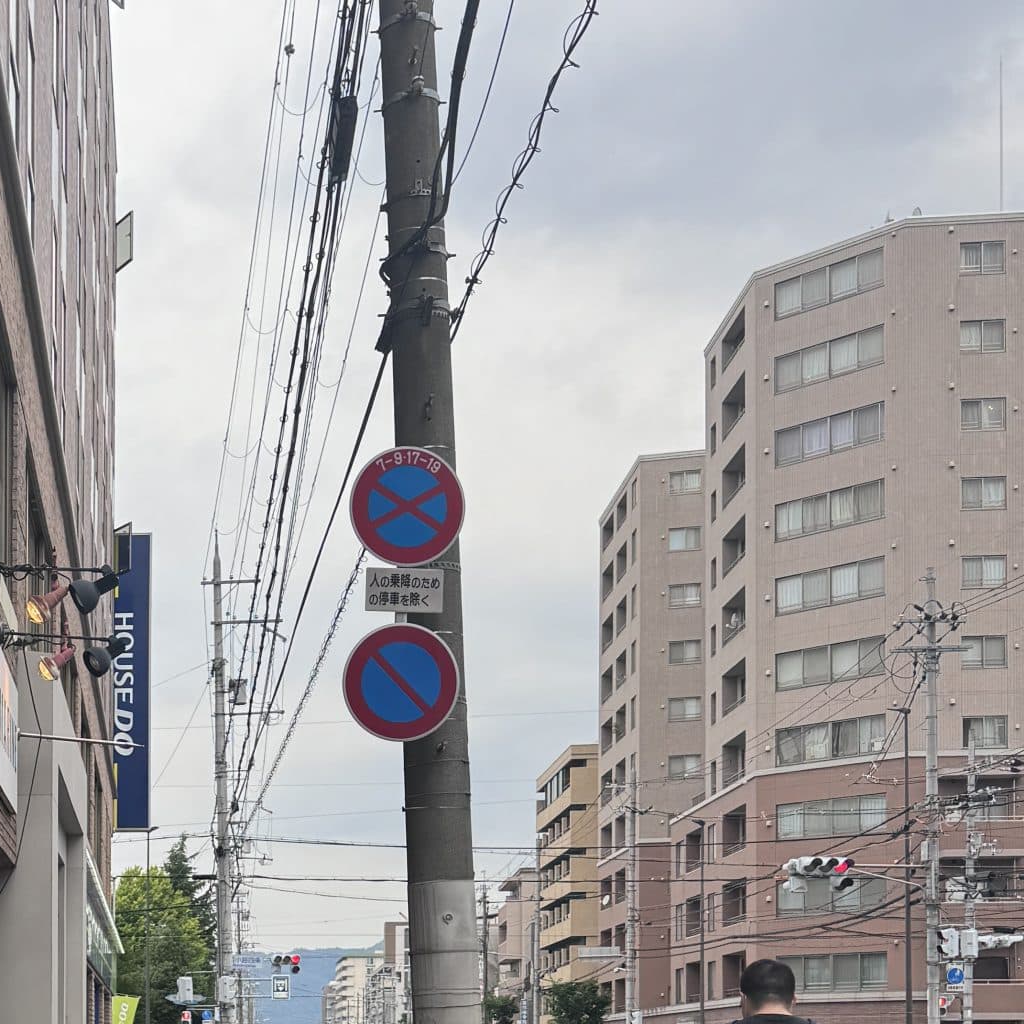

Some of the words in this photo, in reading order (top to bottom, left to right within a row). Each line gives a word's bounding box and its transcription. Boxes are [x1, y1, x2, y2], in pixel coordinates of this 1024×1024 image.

[369, 572, 441, 589] 人の乗降のため
[368, 591, 429, 607] の停車を除く
